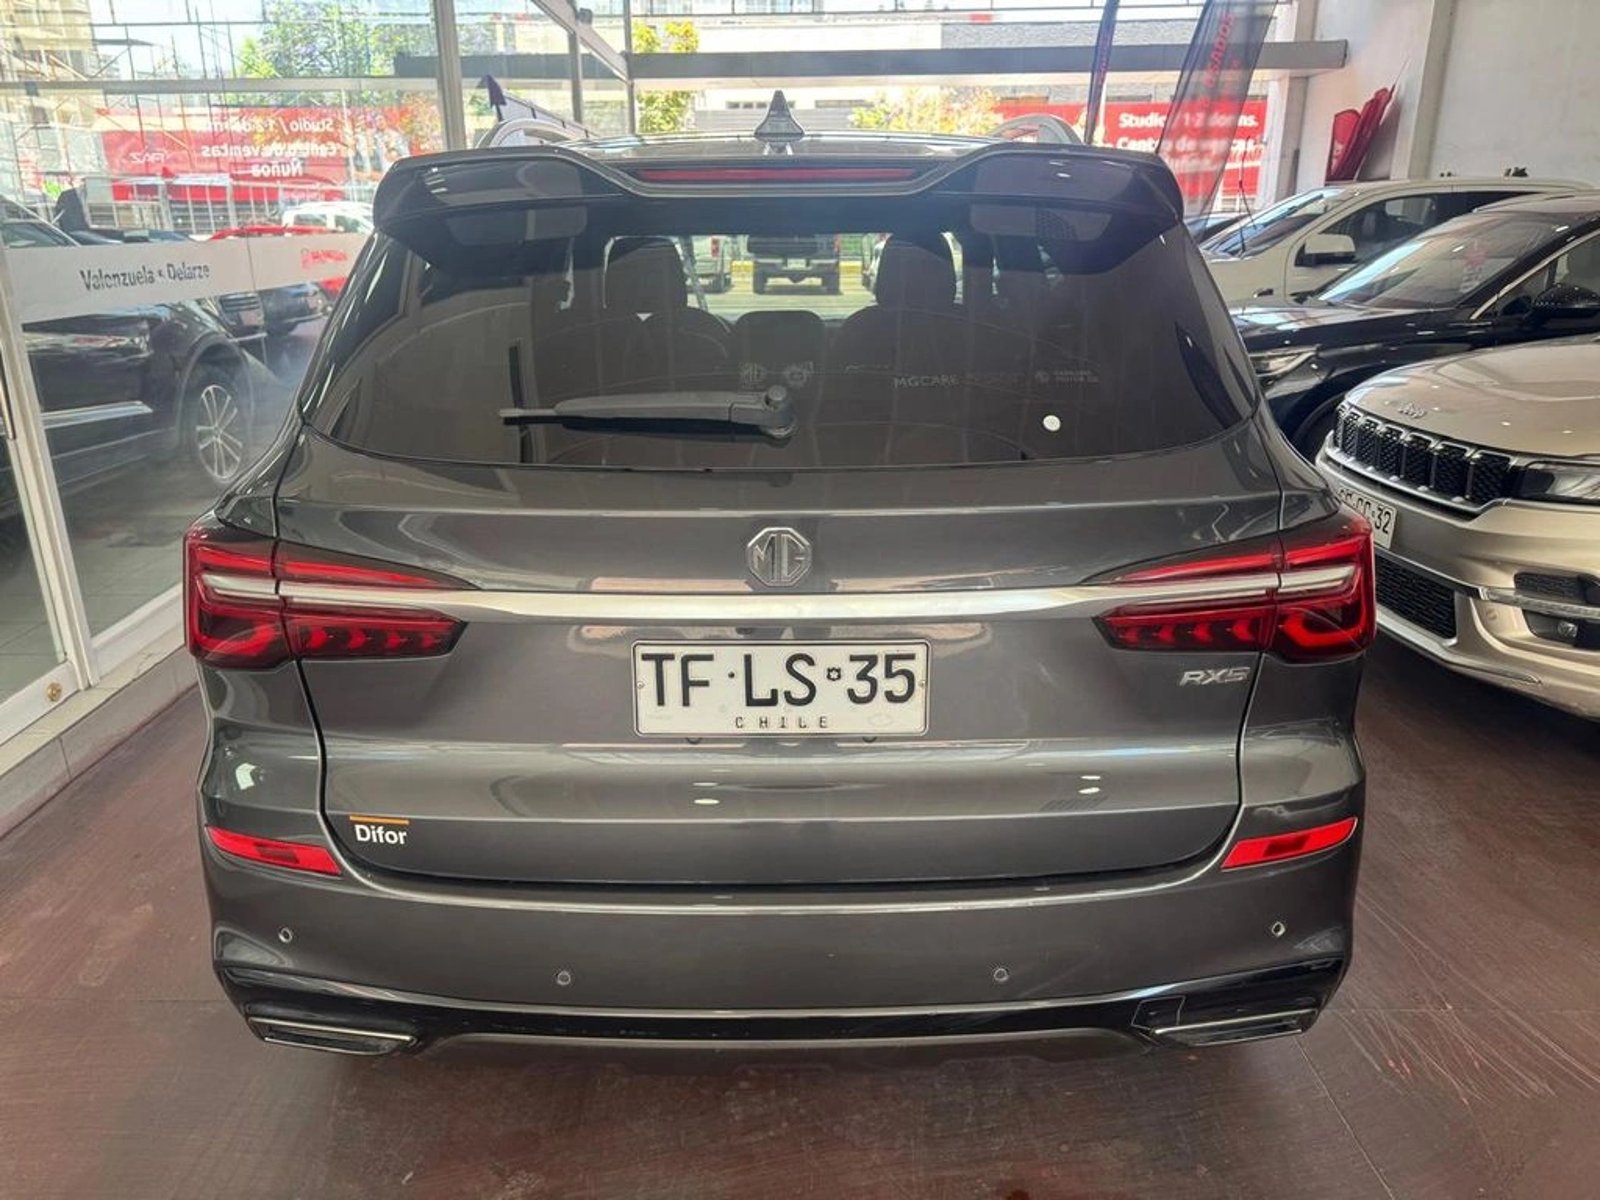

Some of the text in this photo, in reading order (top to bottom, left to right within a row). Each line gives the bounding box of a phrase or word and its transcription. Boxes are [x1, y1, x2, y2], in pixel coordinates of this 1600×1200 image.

[748, 529, 811, 586] MG
[1179, 666, 1251, 687] RX5
[735, 715, 829, 729] CHILE
[354, 824, 407, 845] Difor
